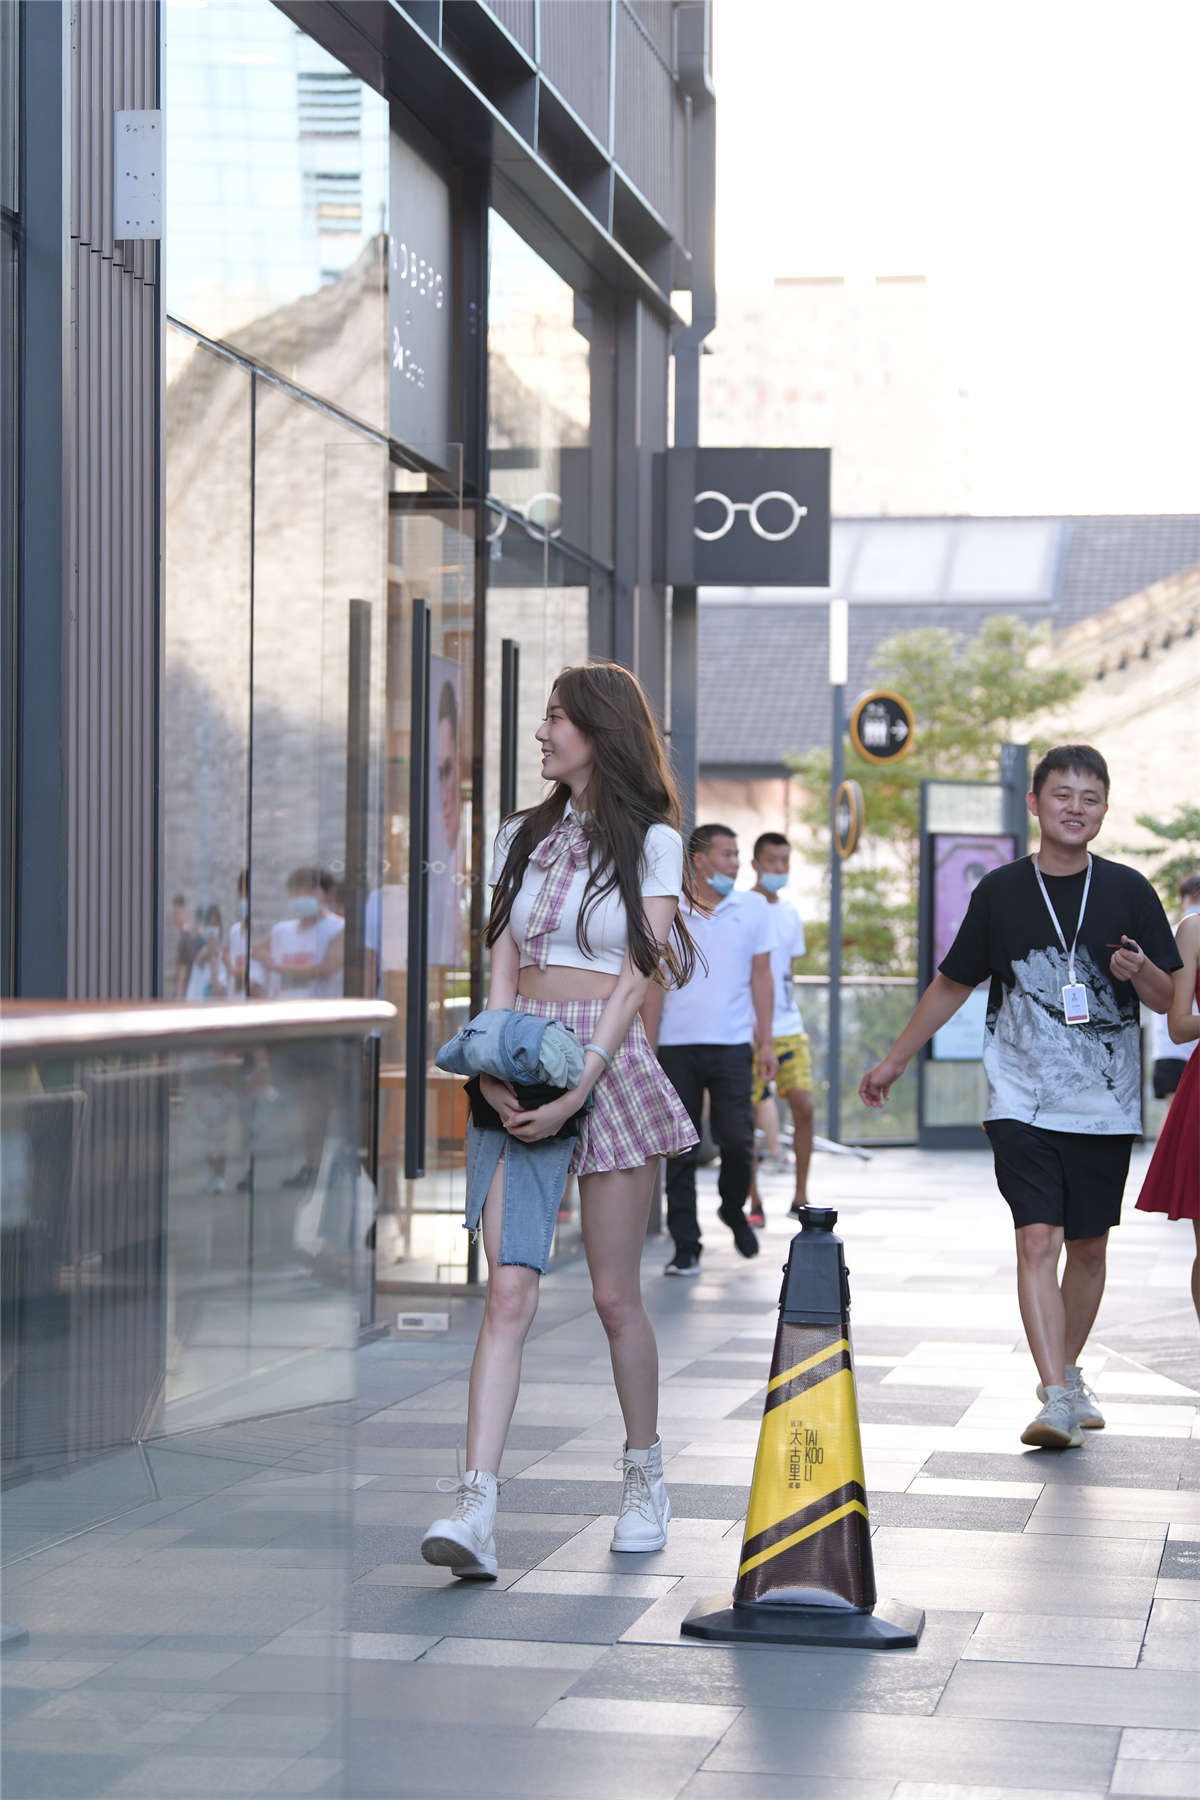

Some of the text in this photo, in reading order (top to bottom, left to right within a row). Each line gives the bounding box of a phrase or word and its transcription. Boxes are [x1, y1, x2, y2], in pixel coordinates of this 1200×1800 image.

[804, 1429, 818, 1446] TAI
[788, 1429, 802, 1481] 太古里
[804, 1447, 824, 1464] KOO
[804, 1465, 812, 1481] LI
